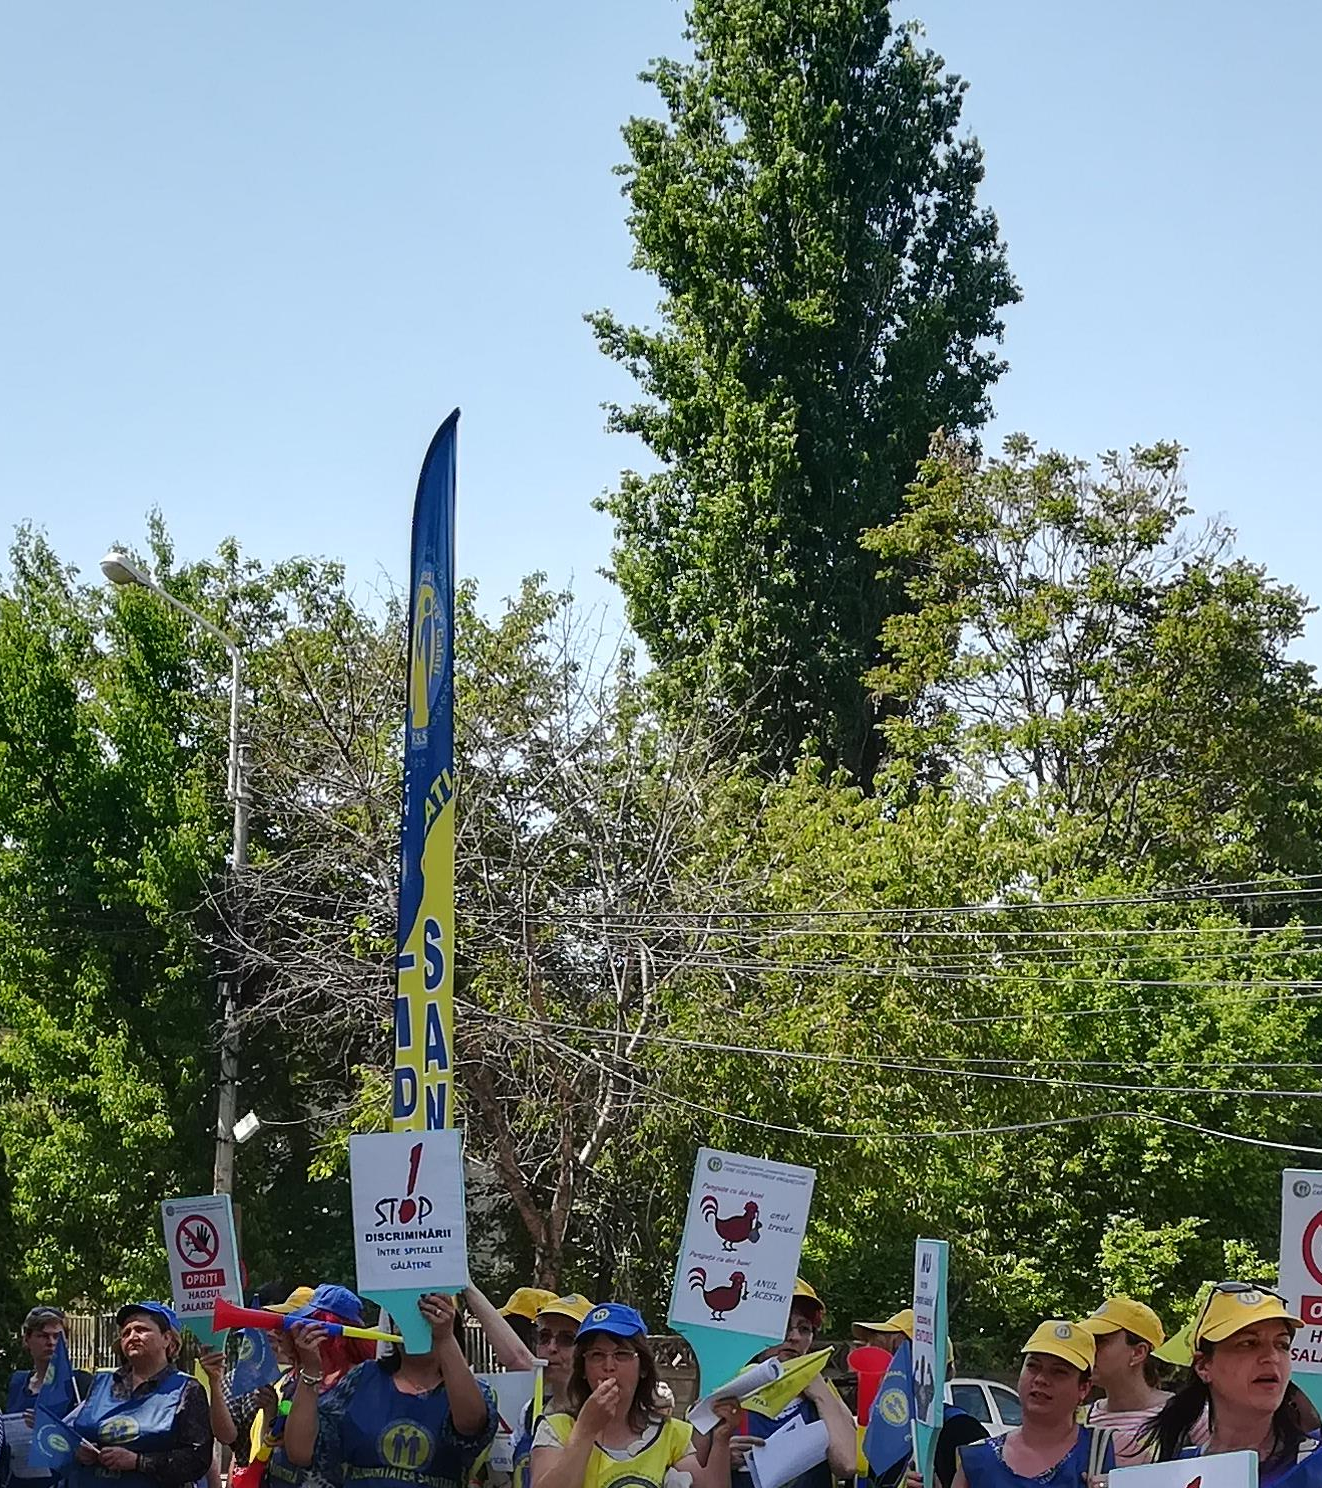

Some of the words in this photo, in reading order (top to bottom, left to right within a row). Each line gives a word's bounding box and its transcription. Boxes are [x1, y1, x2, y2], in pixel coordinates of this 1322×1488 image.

[374, 1195, 433, 1227] STOP
[365, 1228, 452, 1242] DISCRIMINĂRII
[404, 1246, 444, 1256] SPITALELE
[186, 1273, 218, 1286] OPRIȚI
[754, 1280, 777, 1289] ANUL
